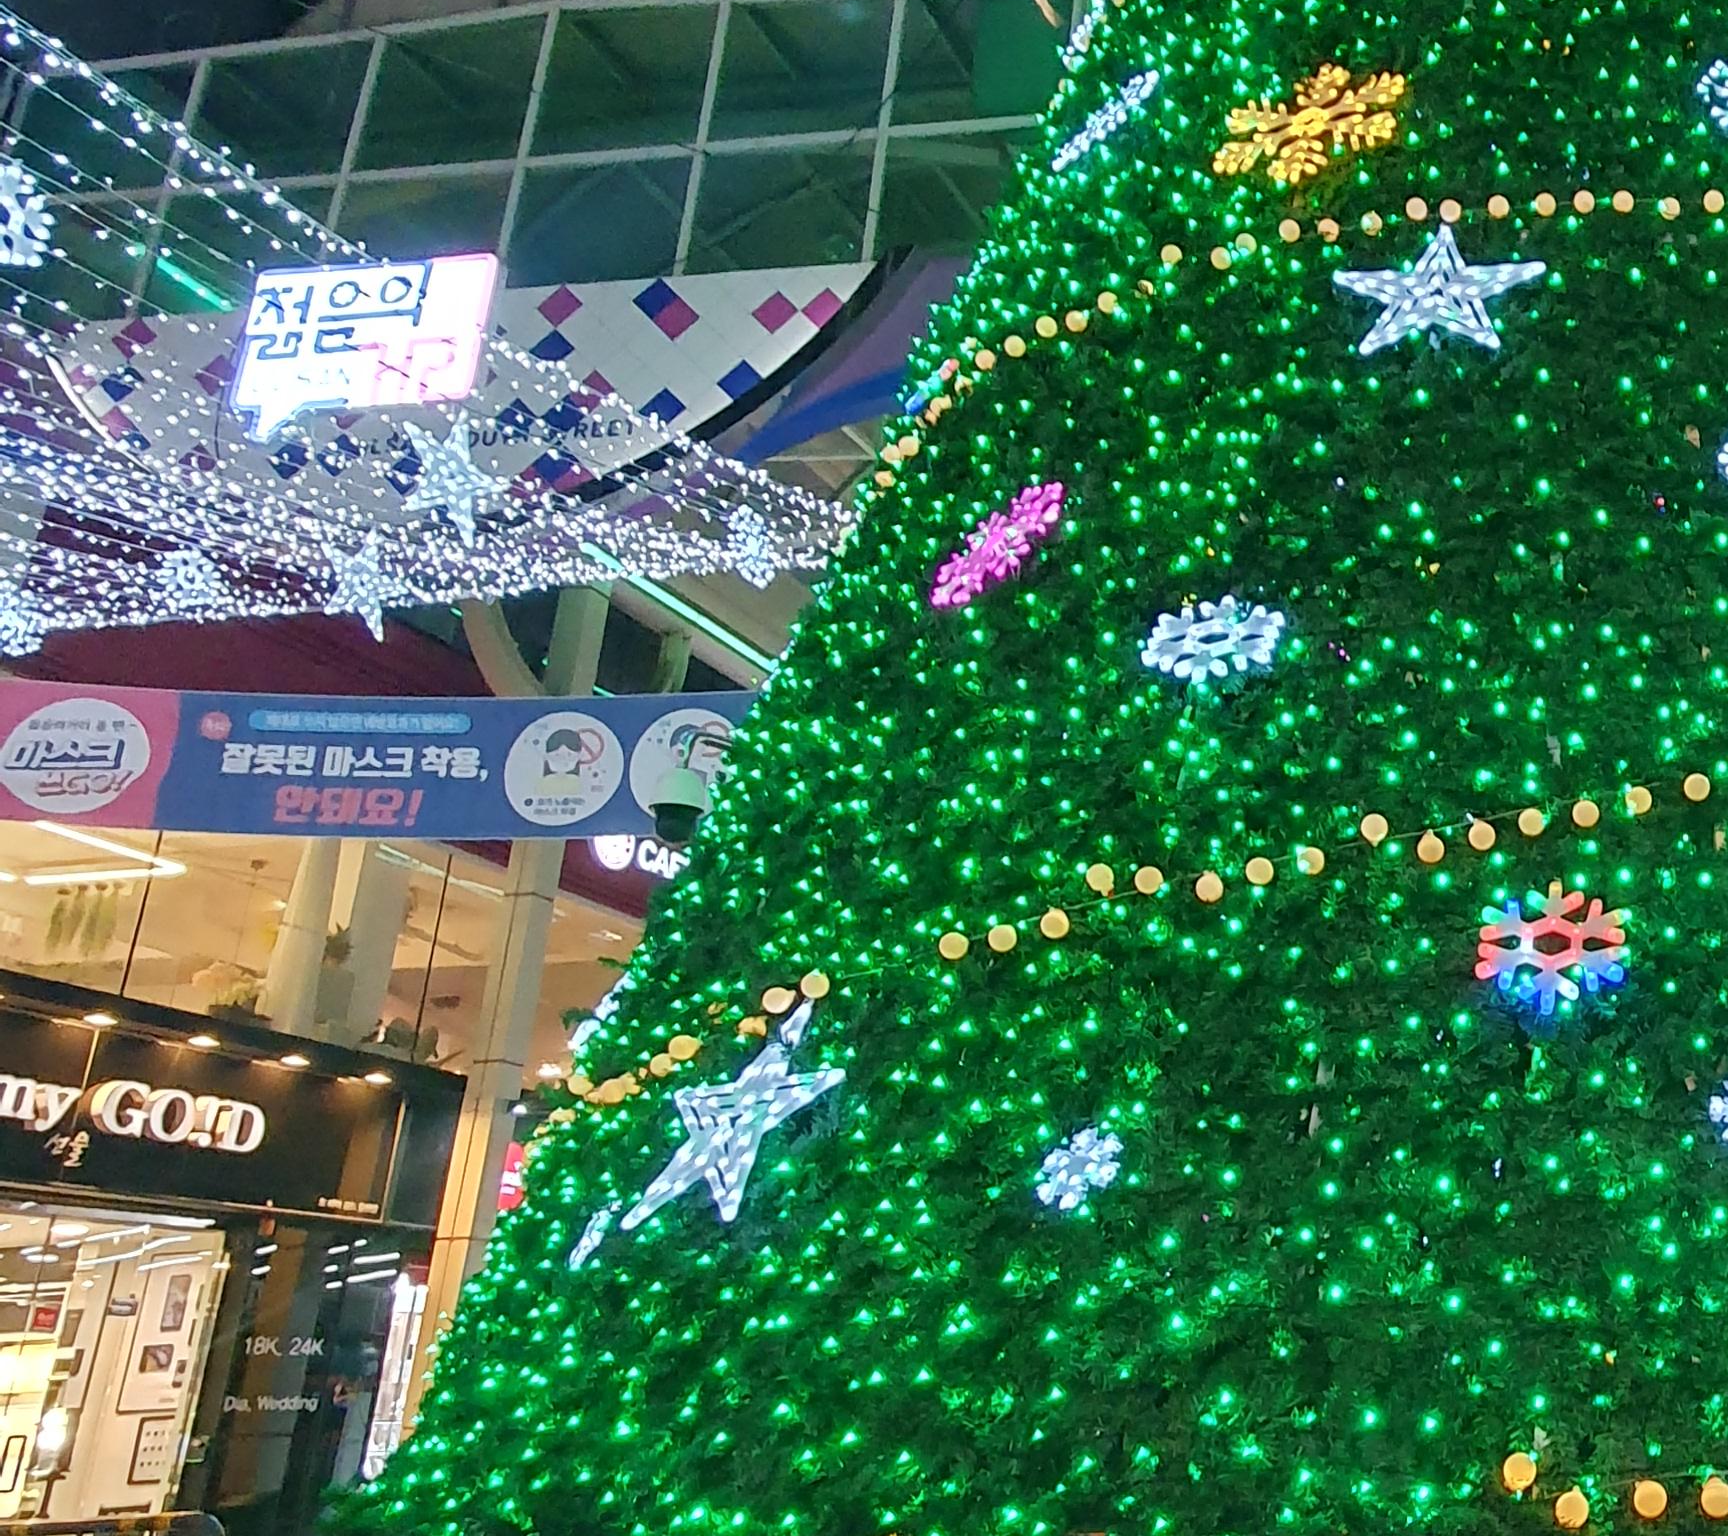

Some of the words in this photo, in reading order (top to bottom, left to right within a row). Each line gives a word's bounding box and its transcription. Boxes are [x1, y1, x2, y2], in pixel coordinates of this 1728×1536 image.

[5, 738, 126, 770] 마스크
[220, 742, 317, 776] 잘못된
[322, 746, 414, 778] 마스크
[420, 746, 489, 782] 착용,
[272, 785, 424, 827] 안돼요!
[288, 1336, 325, 1356] 24K
